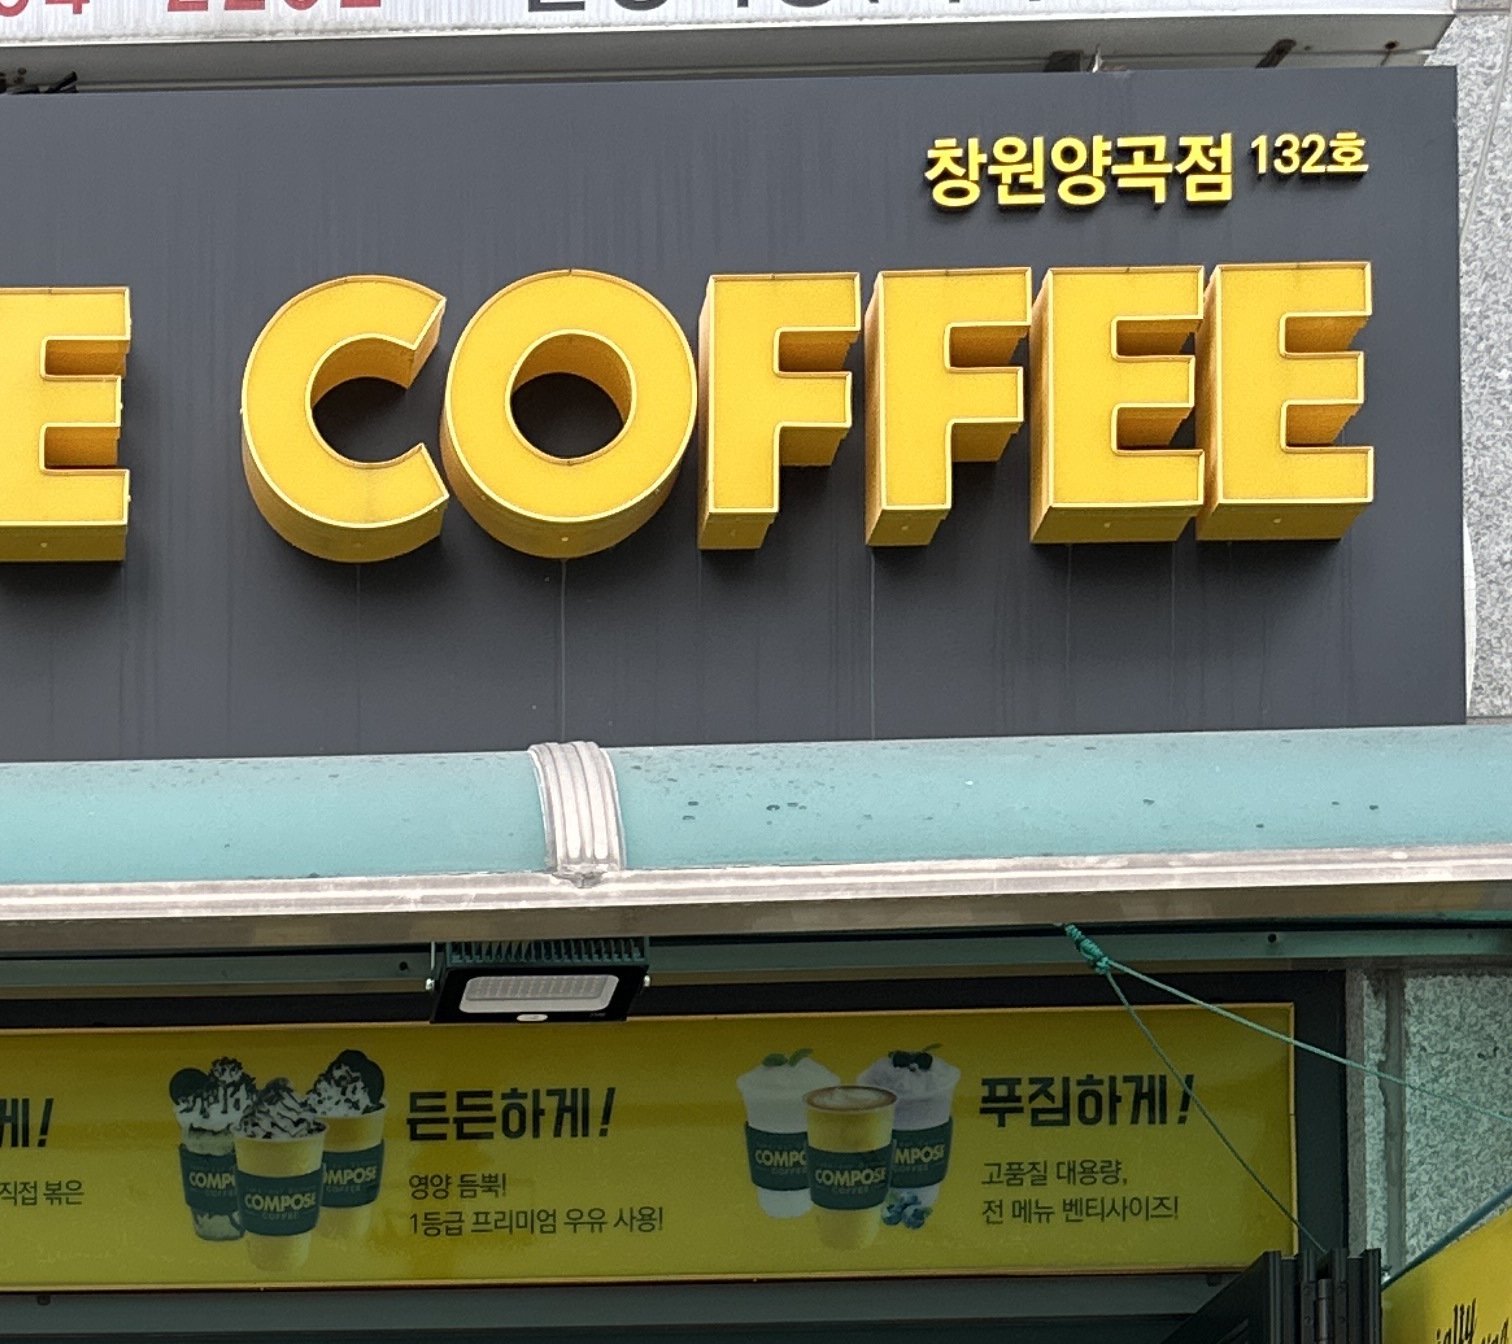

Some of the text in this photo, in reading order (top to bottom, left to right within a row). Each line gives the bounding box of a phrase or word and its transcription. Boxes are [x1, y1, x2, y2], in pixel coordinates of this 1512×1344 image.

[924, 131, 1370, 208] 창원양곡점 132호
[240, 261, 1375, 564] COFFEE
[406, 1086, 617, 1142] 든든하게!
[978, 1073, 1196, 1128] 푸짐하게!
[755, 1149, 807, 1167] COMPO
[188, 1172, 236, 1190] COMP
[408, 1172, 508, 1201] 영양 듬뿍!
[980, 1159, 1129, 1188] 고품질 대용량,
[43, 1178, 86, 1206] 볶은
[408, 1207, 665, 1237] 1등급 프리미엄 우유 사용!
[981, 1195, 1181, 1225] 전 메뉴 벤티사이즈!
